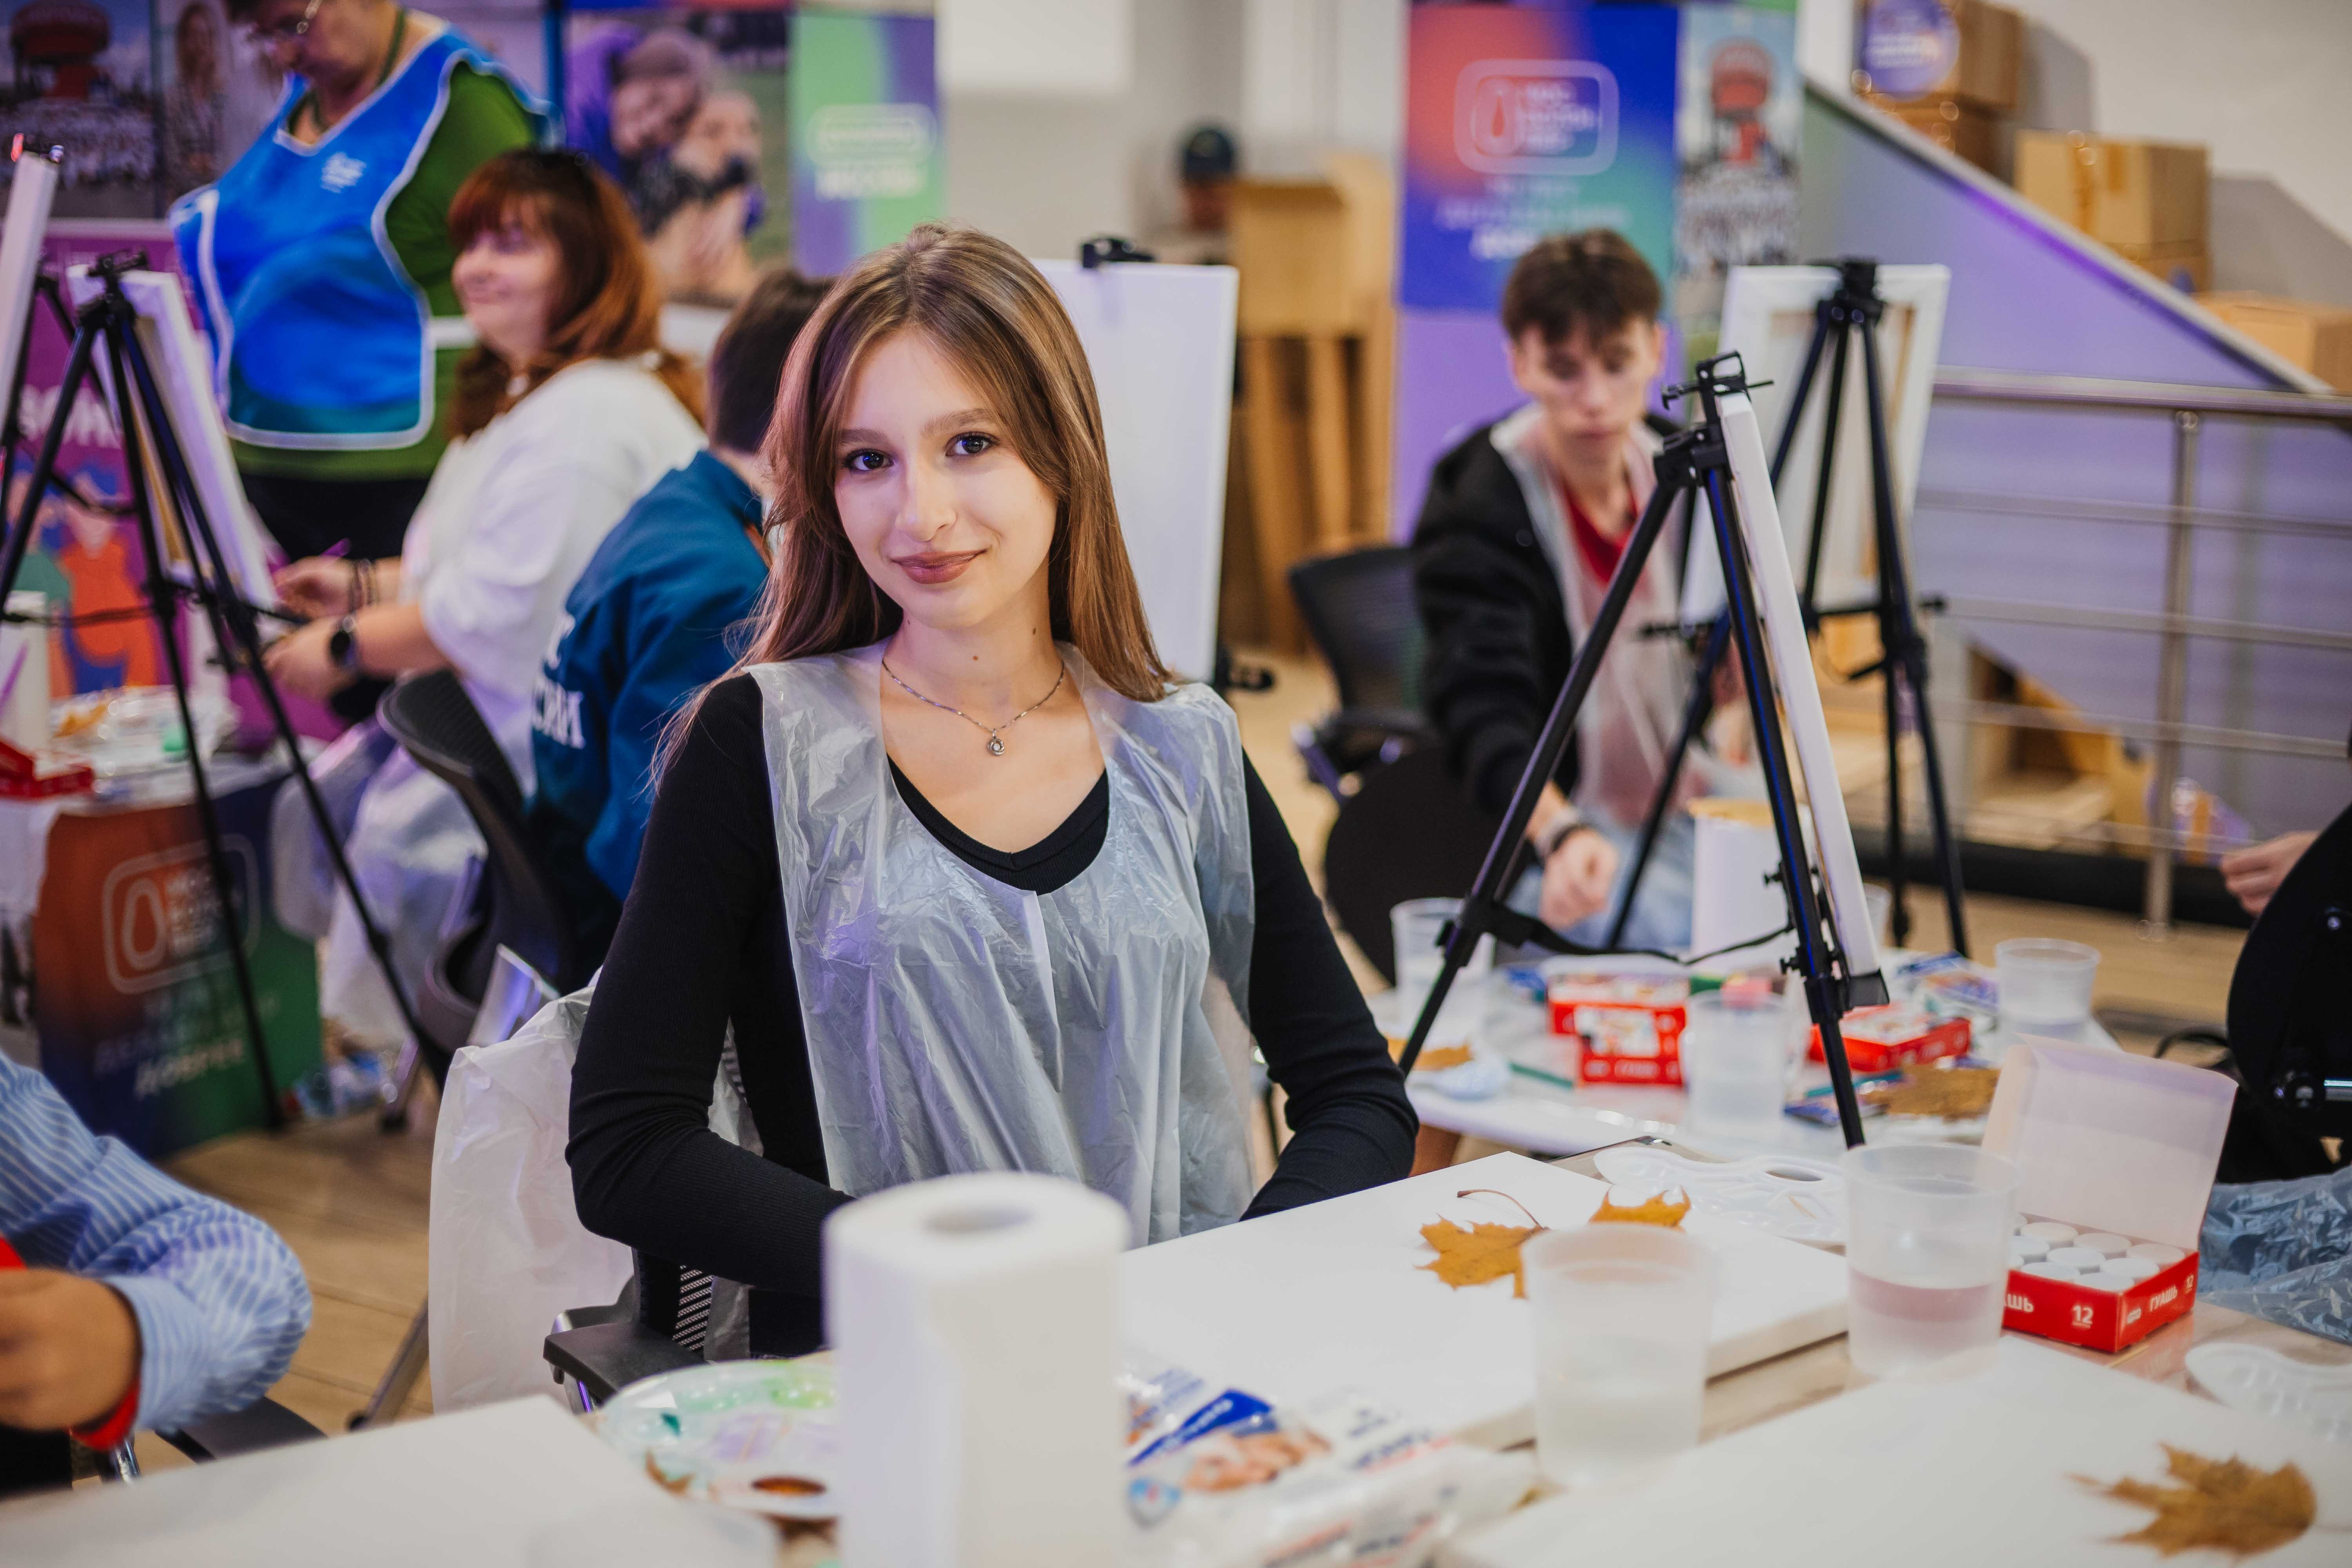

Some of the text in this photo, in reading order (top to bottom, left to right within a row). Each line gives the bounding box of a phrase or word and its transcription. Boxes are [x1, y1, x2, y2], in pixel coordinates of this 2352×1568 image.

[2186, 1274, 2194, 1289] 12
[2004, 1293, 2034, 1313] ШЬ
[2149, 1285, 2178, 1312] ГУАШЬ
[2073, 1304, 2094, 1325] 12
